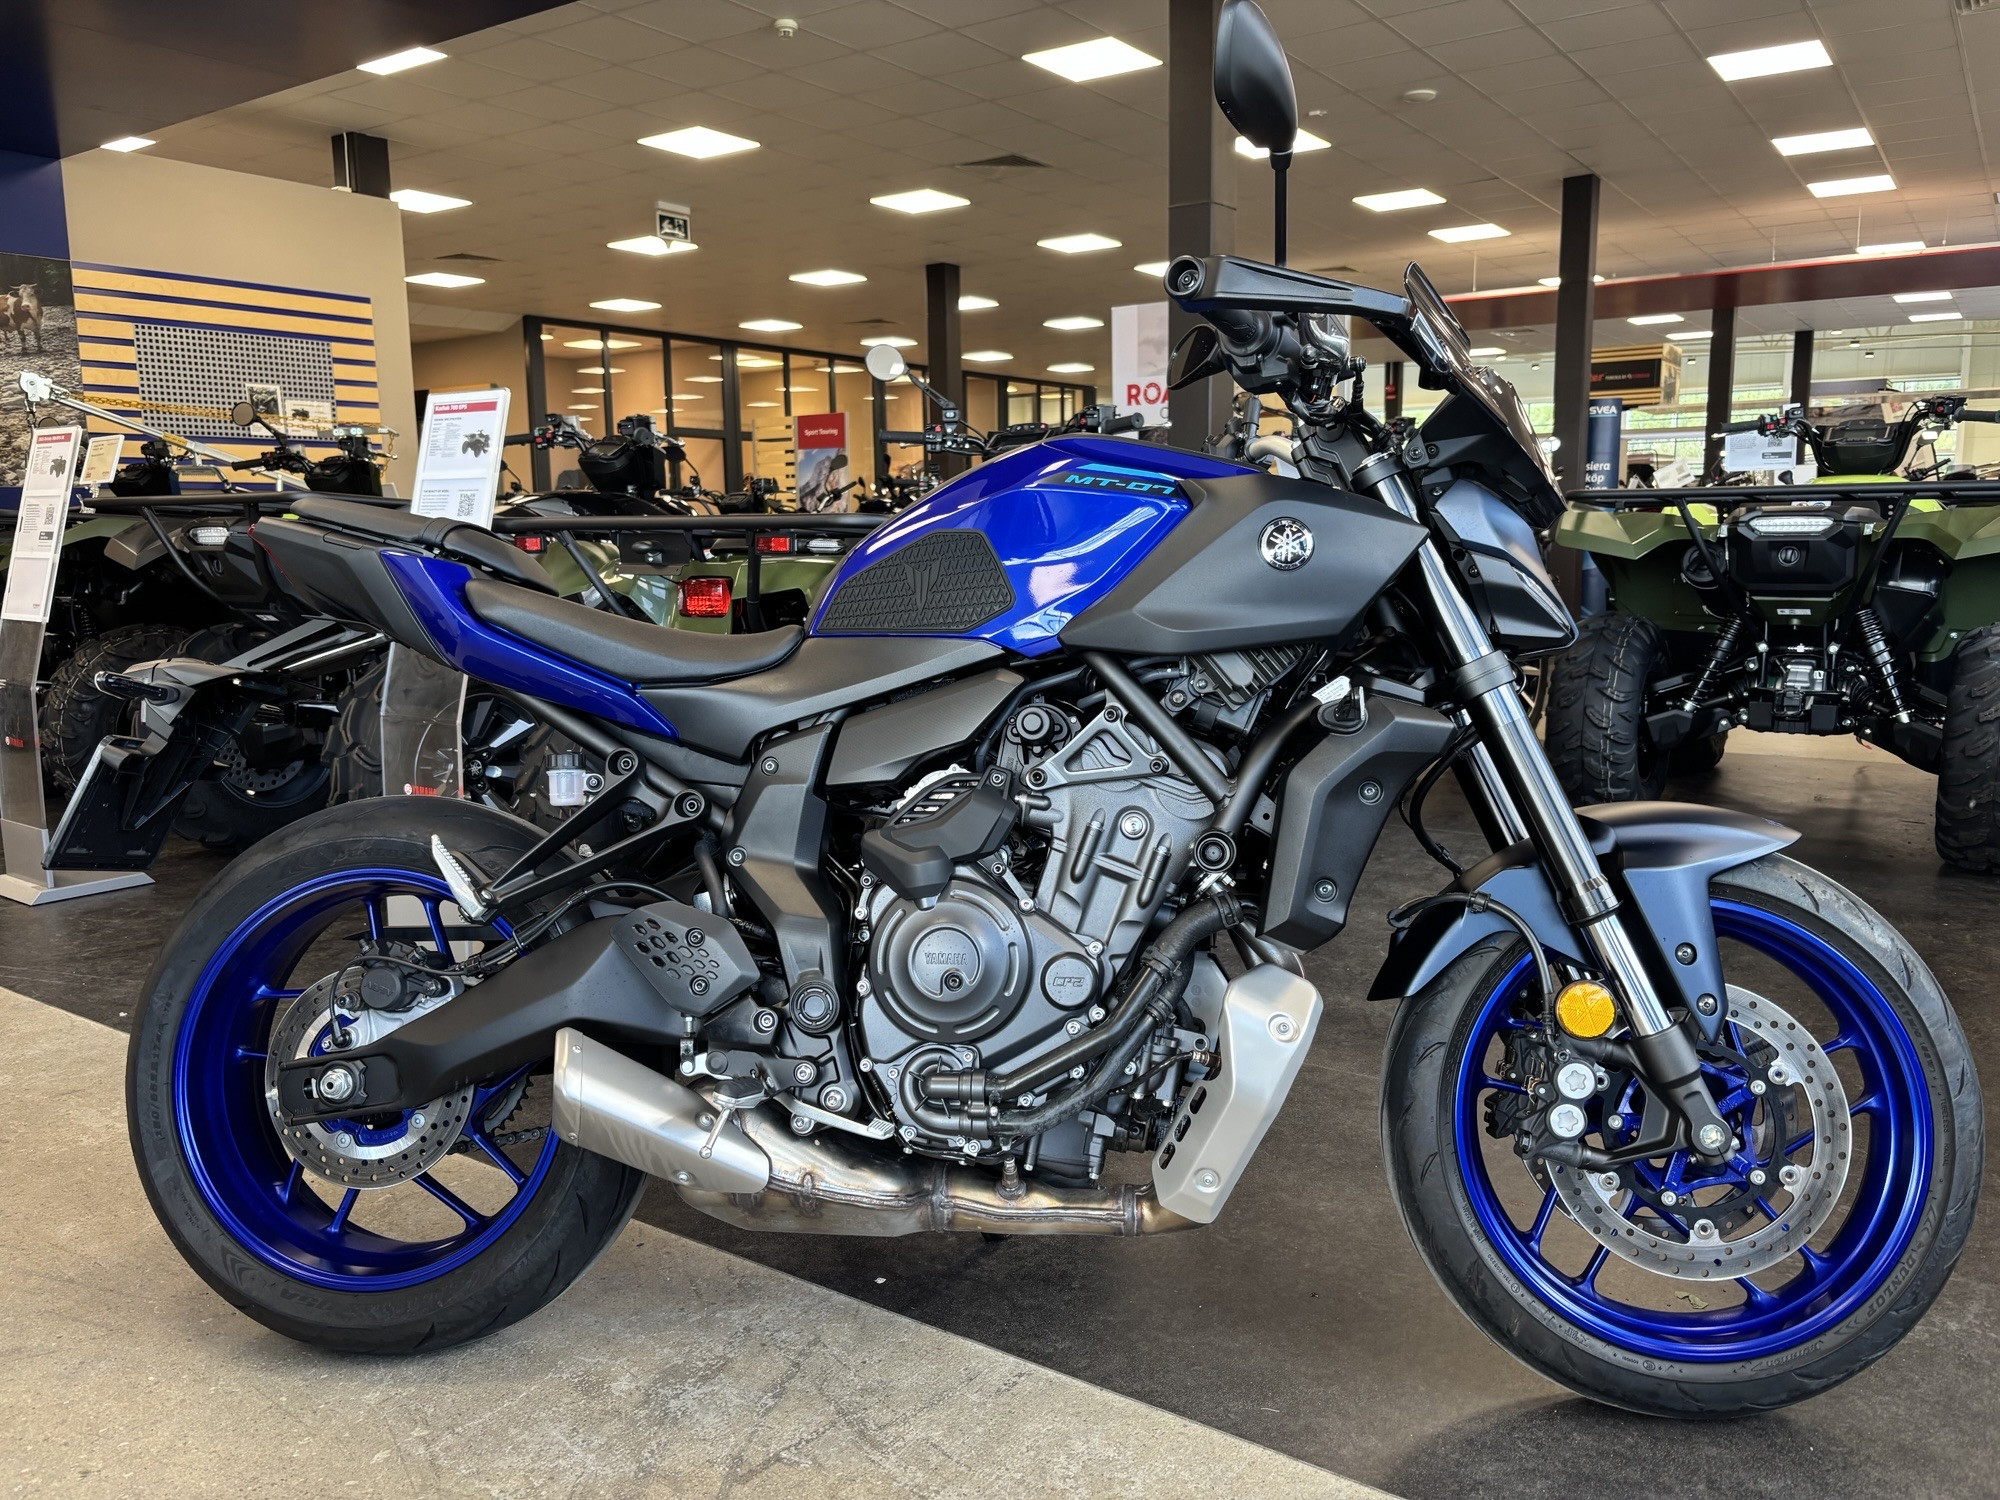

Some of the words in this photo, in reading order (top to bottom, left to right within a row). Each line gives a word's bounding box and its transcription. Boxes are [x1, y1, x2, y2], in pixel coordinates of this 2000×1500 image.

[1589, 405, 1618, 415] SVEA
[804, 429, 819, 437] Sport
[820, 428, 839, 436] Touring
[1064, 474, 1176, 495] MT-07
[1584, 472, 1605, 485] köp
[924, 952, 969, 966] YAMAHA
[1939, 1096, 1949, 1132] TUBELESS
[1862, 1252, 1919, 1318] DUNLOP
